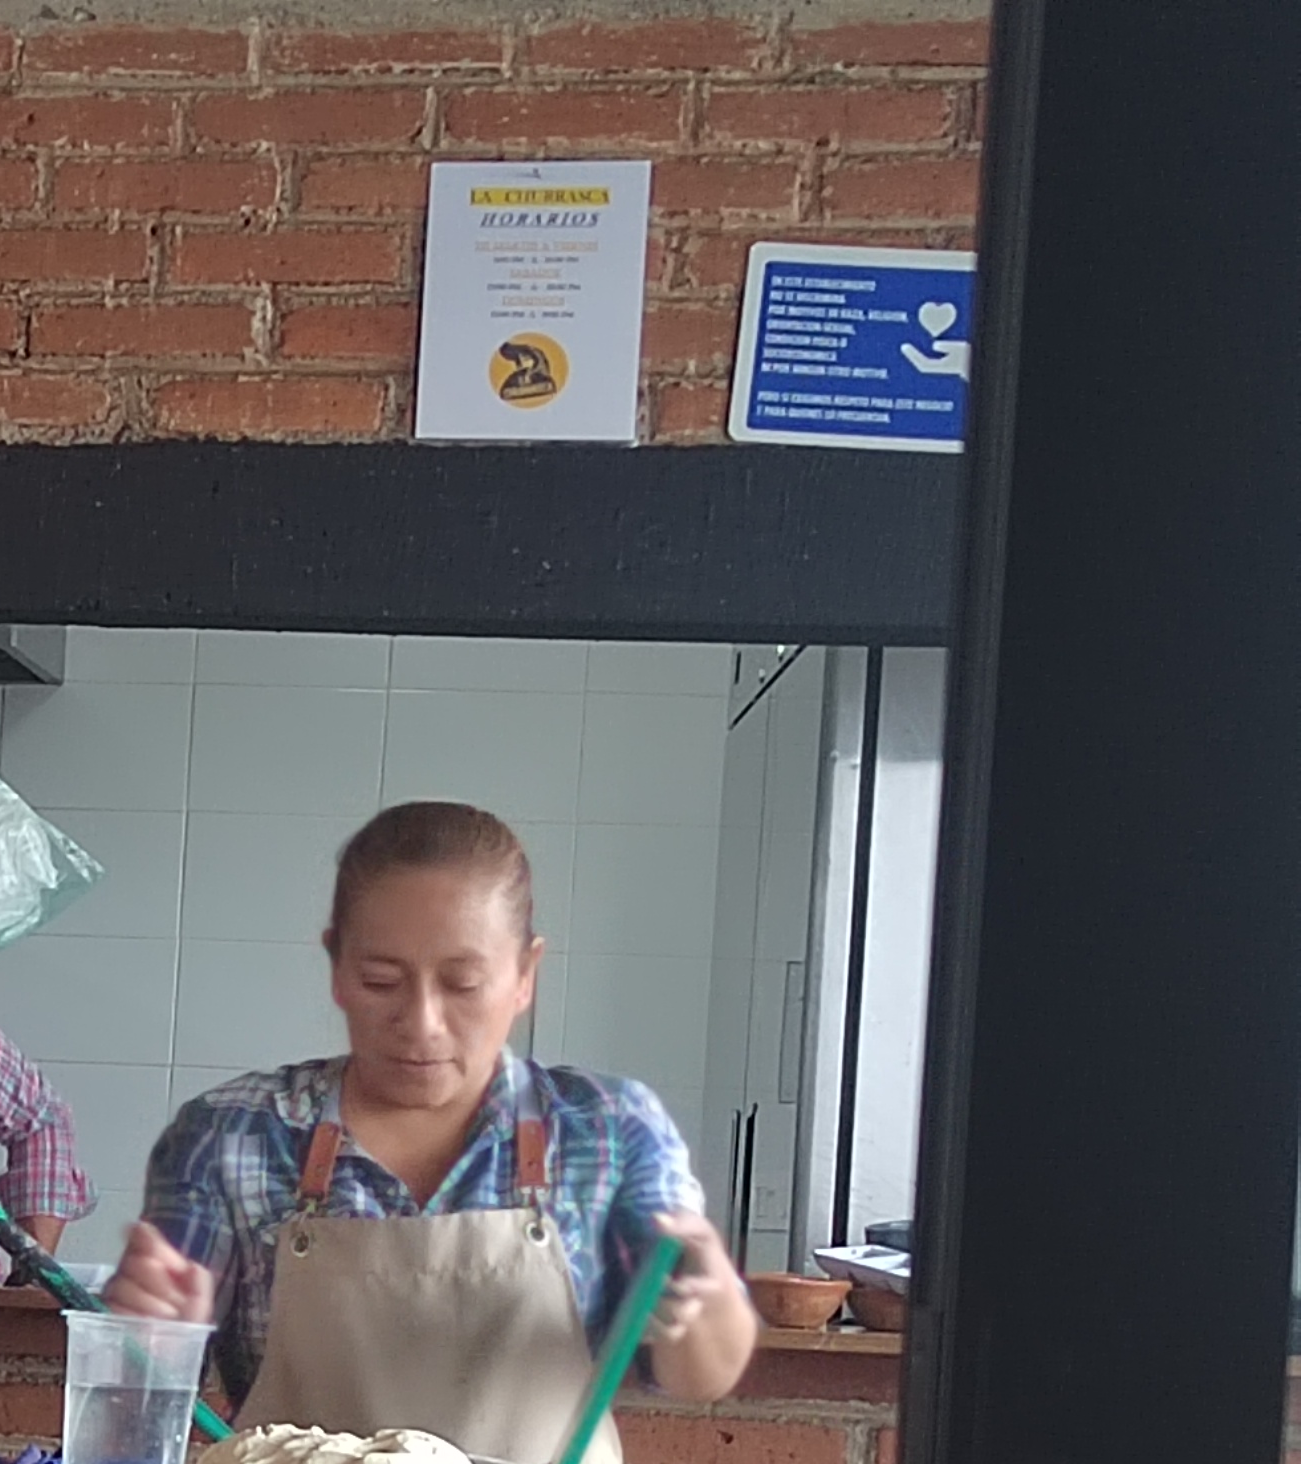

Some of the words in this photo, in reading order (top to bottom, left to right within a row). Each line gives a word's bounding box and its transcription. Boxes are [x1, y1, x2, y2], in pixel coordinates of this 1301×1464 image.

[469, 188, 493, 205] LA
[504, 188, 610, 205] CHURRASCA
[479, 211, 601, 228] HORARIOS
